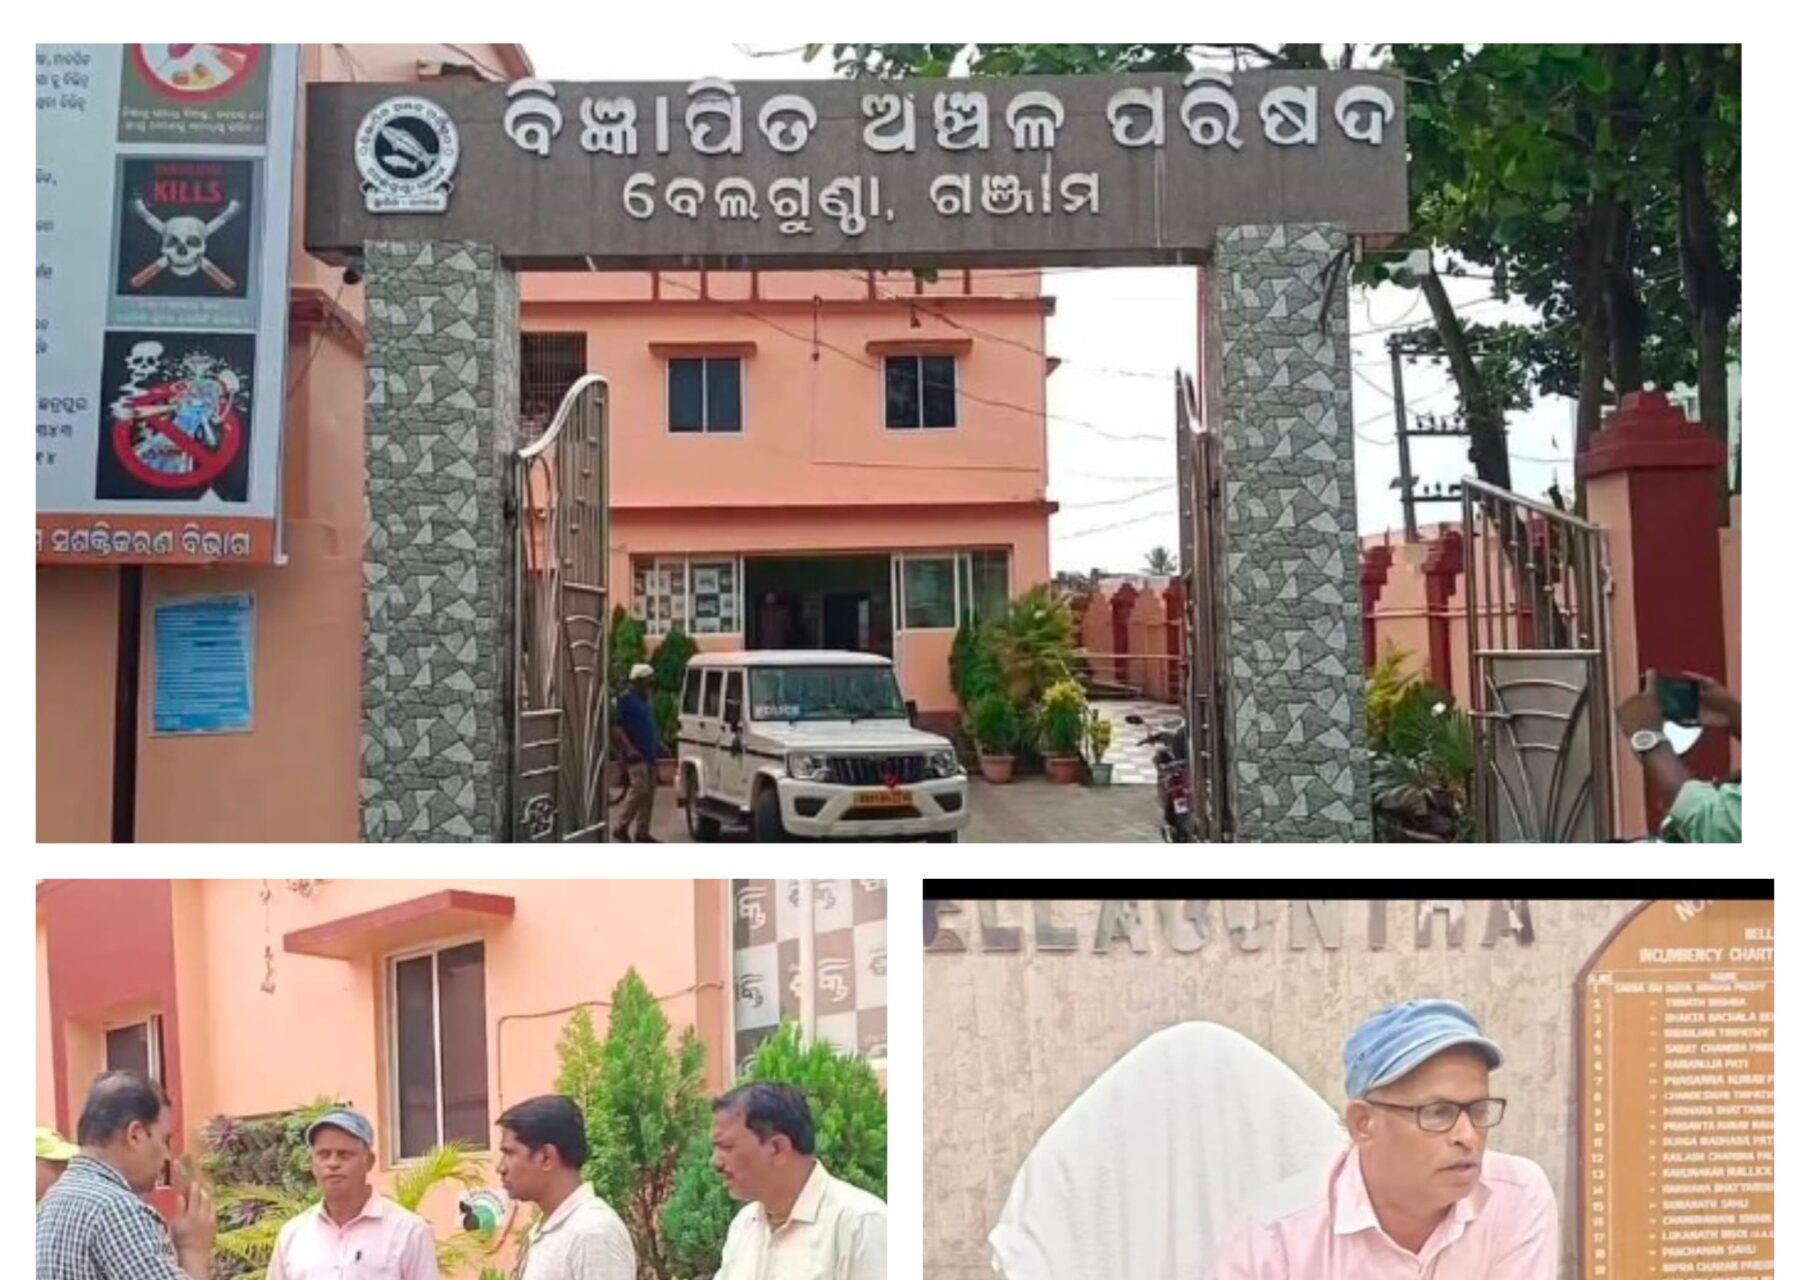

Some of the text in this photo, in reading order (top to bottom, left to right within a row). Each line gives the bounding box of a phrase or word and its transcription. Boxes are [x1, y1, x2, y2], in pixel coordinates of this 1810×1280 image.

[505, 78, 817, 156] ବିଜ୍ଞାପିତ
[862, 90, 1065, 152] ଅଞ୍ଚଳ
[1107, 72, 1396, 150] ପରିଷଦ
[156, 181, 223, 202] KILLS
[929, 172, 1100, 215] ଗଞ୍ଜାମ
[182, 522, 250, 556] ବିଭାଗ
